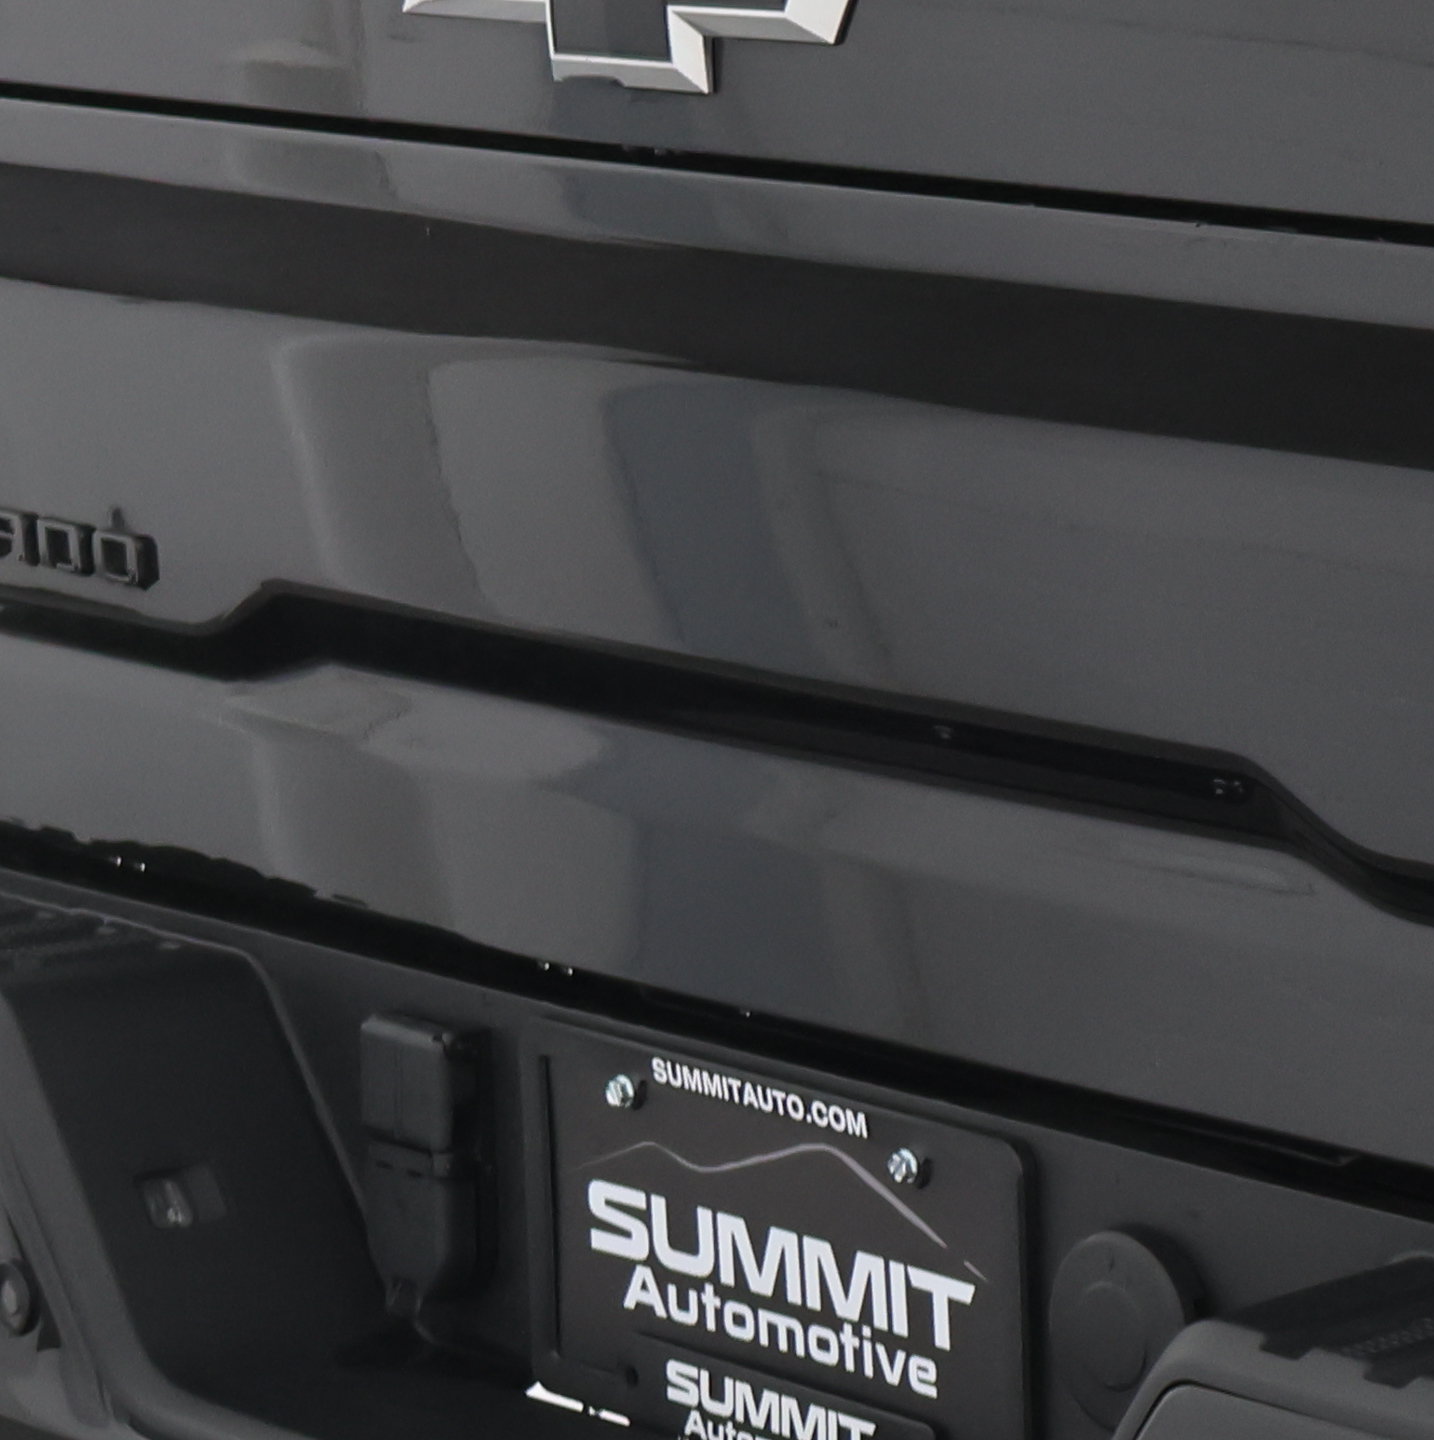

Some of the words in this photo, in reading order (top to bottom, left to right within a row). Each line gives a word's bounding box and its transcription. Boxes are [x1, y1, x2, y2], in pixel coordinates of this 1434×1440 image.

[651, 1056, 868, 1139] SUMMITAUTO.COM
[588, 1179, 976, 1351] SUMMIT
[623, 1264, 938, 1399] Automotive
